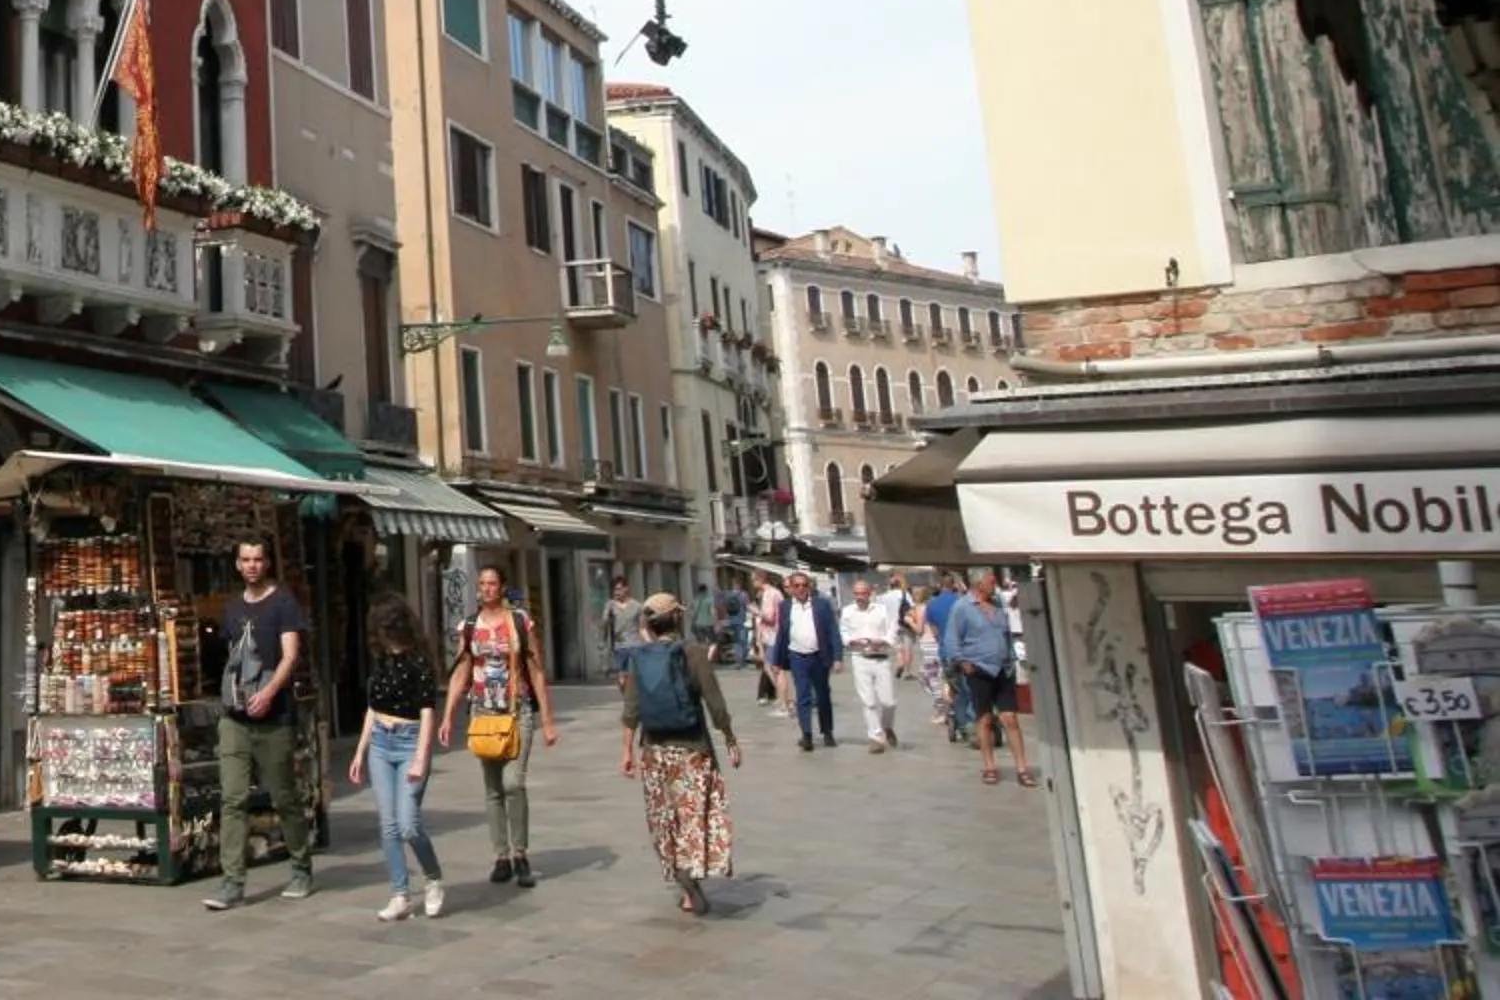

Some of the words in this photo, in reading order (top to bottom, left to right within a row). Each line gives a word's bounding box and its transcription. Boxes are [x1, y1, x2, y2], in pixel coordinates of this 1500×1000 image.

[1066, 490, 1292, 546] Bottega
[1320, 483, 1500, 534] Nobil
[1265, 612, 1378, 650] VENEZIA
[1404, 687, 1471, 717] €3,50
[1319, 882, 1439, 917] VENEZIA
